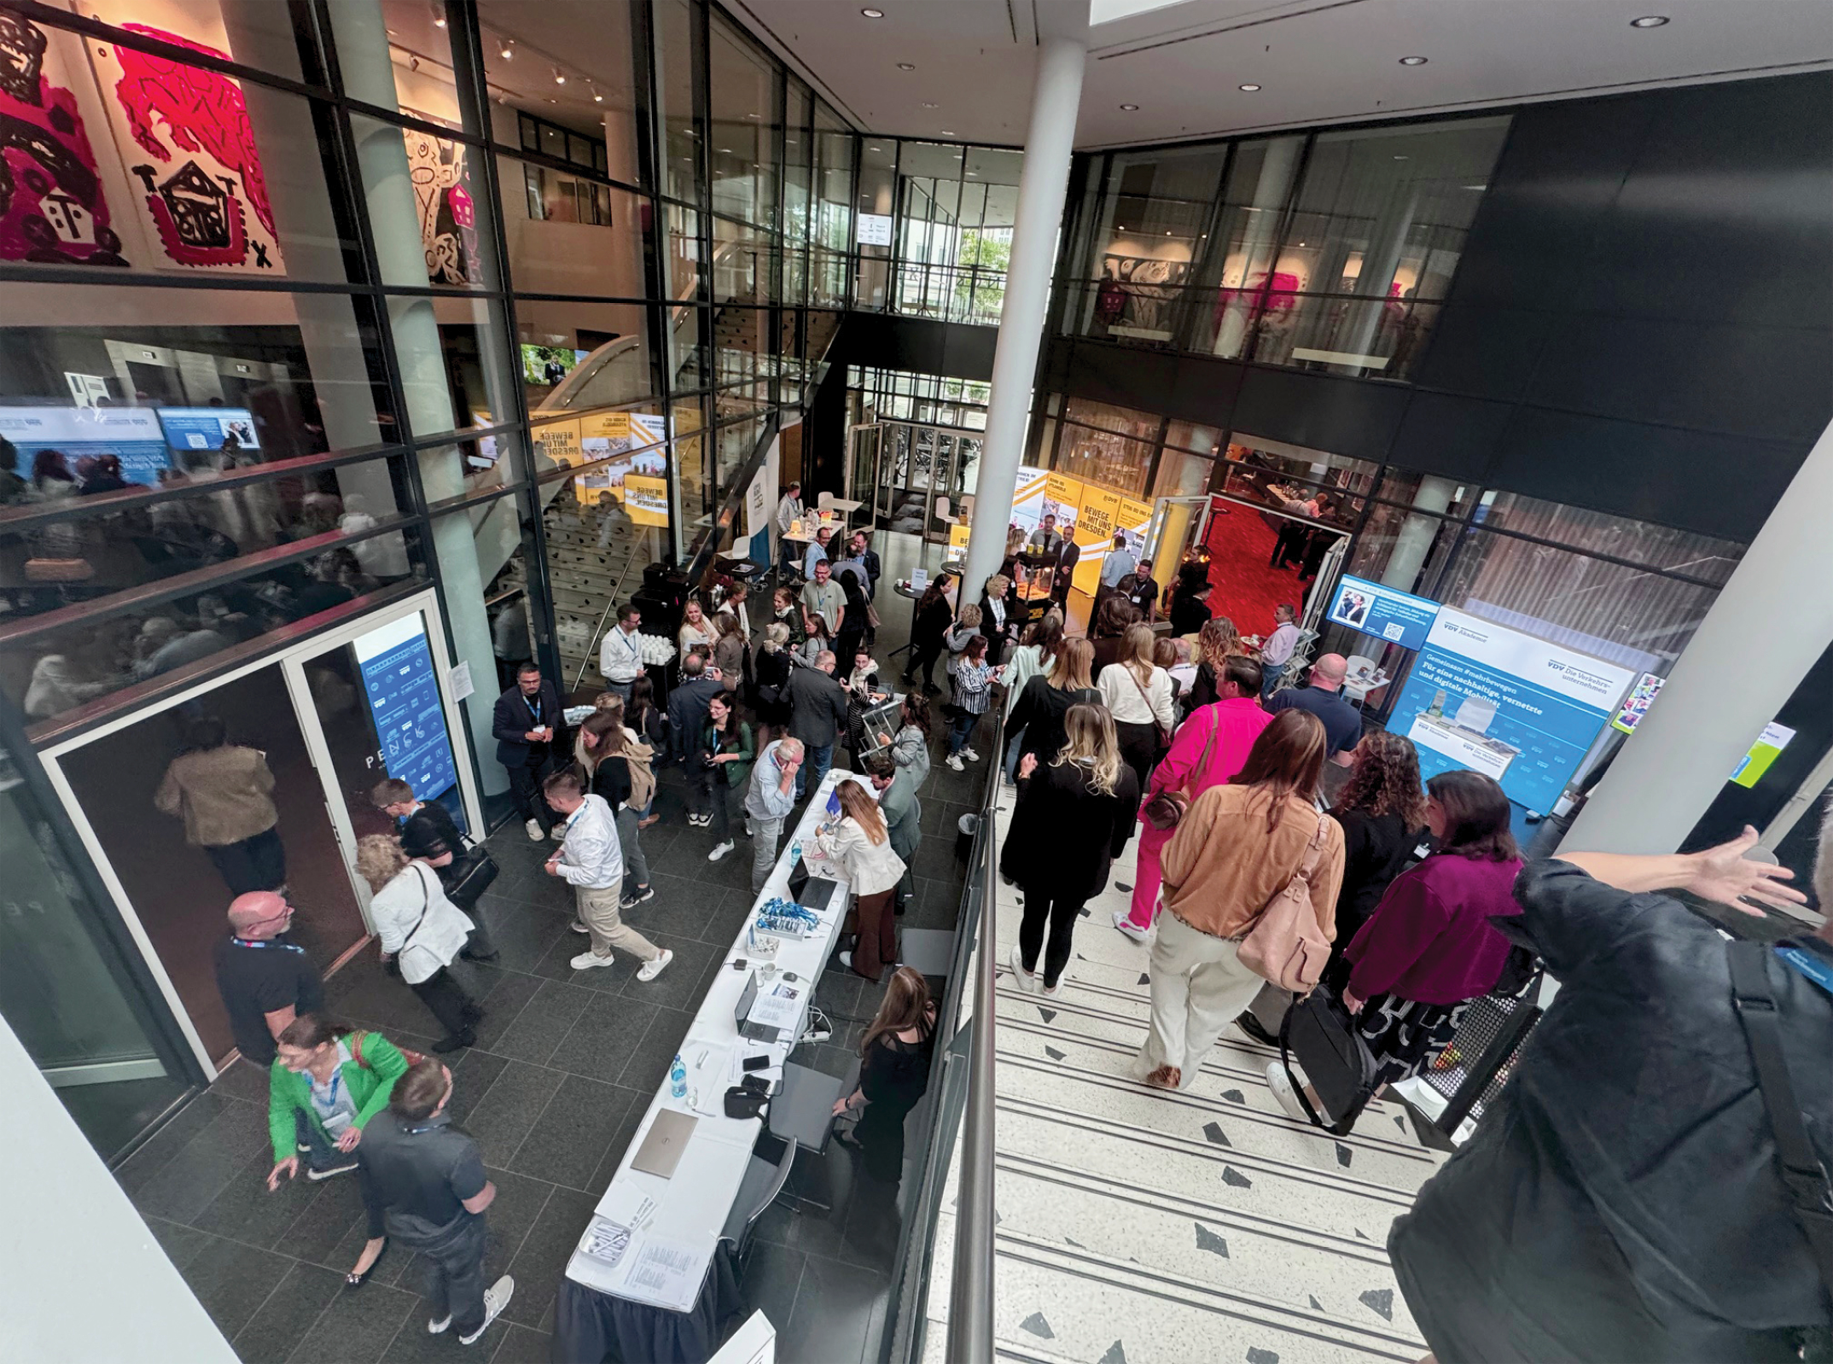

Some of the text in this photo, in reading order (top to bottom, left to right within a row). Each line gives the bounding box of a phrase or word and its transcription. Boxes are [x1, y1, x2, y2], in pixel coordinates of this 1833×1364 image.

[1084, 505, 1110, 522] BEWEGE
[1087, 515, 1098, 526] MIT
[1098, 519, 1112, 531] UNS
[1078, 520, 1106, 538] DRESDEN.
[1444, 624, 1487, 643] VDV Akademie
[1418, 670, 1433, 681] und
[1434, 676, 1463, 692] digitale
[1426, 654, 1517, 695] Gemeinsam #mehrbewegen
[1548, 661, 1611, 688] VDV Die Verkehrs-
[1562, 674, 1607, 694] unternehmen
[1422, 661, 1543, 716] Für eine nachhaltige, vernetzte
[366, 724, 424, 769] PENCK
[1463, 743, 1474, 752] VDV
